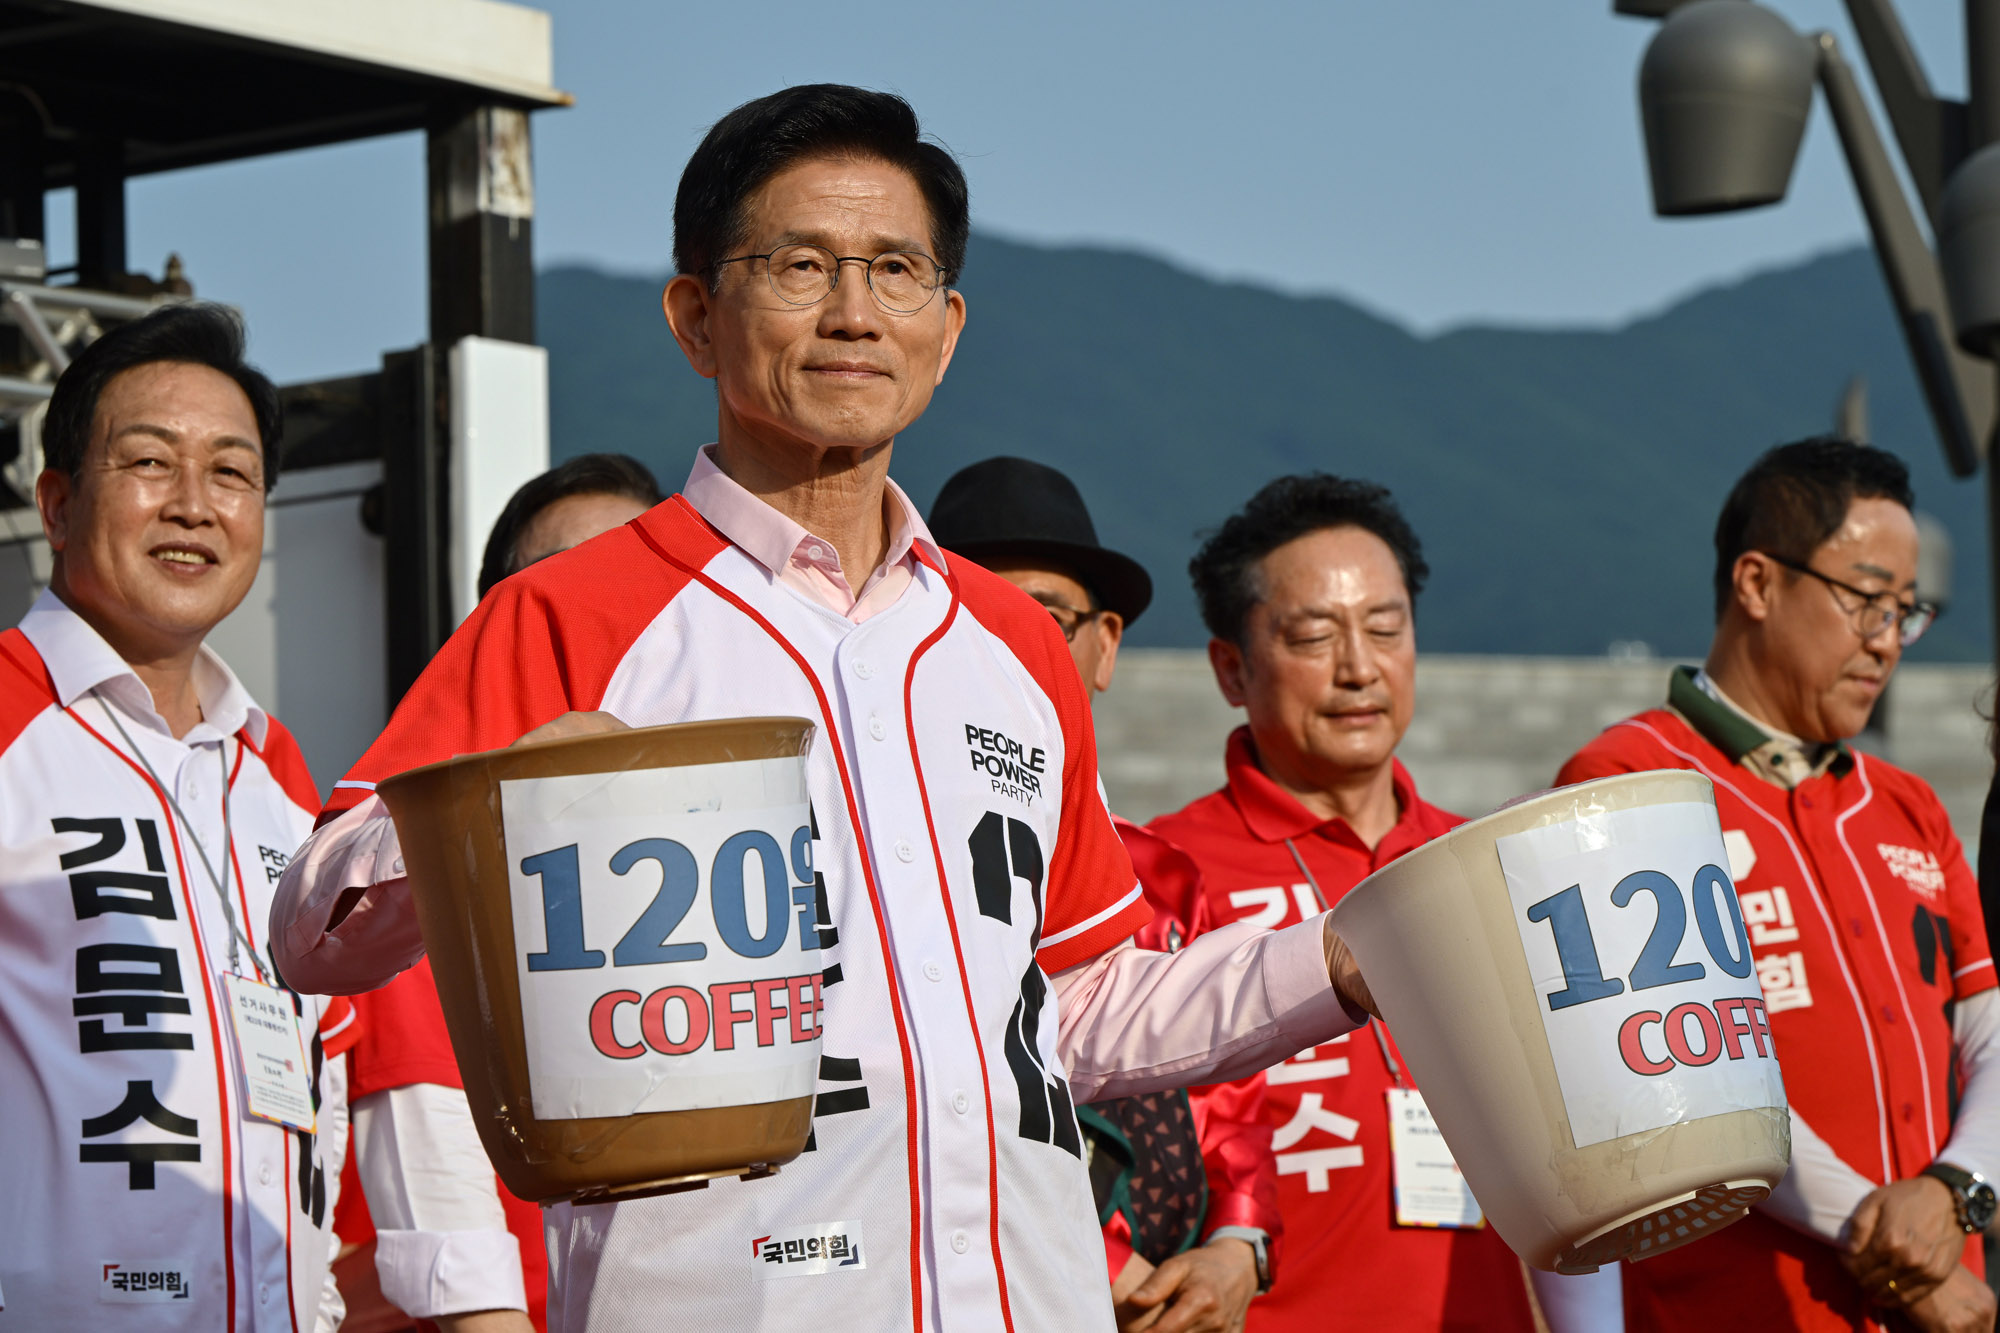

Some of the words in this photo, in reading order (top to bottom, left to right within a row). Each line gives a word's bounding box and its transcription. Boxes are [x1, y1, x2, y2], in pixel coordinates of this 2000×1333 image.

[964, 723, 1046, 774] PEOPLE
[970, 749, 1043, 799] POWER
[991, 779, 1034, 808] PARTY
[1527, 863, 1752, 1012] 120
[51, 817, 201, 1191] 김문수
[588, 972, 825, 1060] COFFEE
[1617, 997, 1779, 1077] COFF
[763, 1234, 850, 1264] 국민의힘
[112, 1271, 181, 1292] 국민의힘
